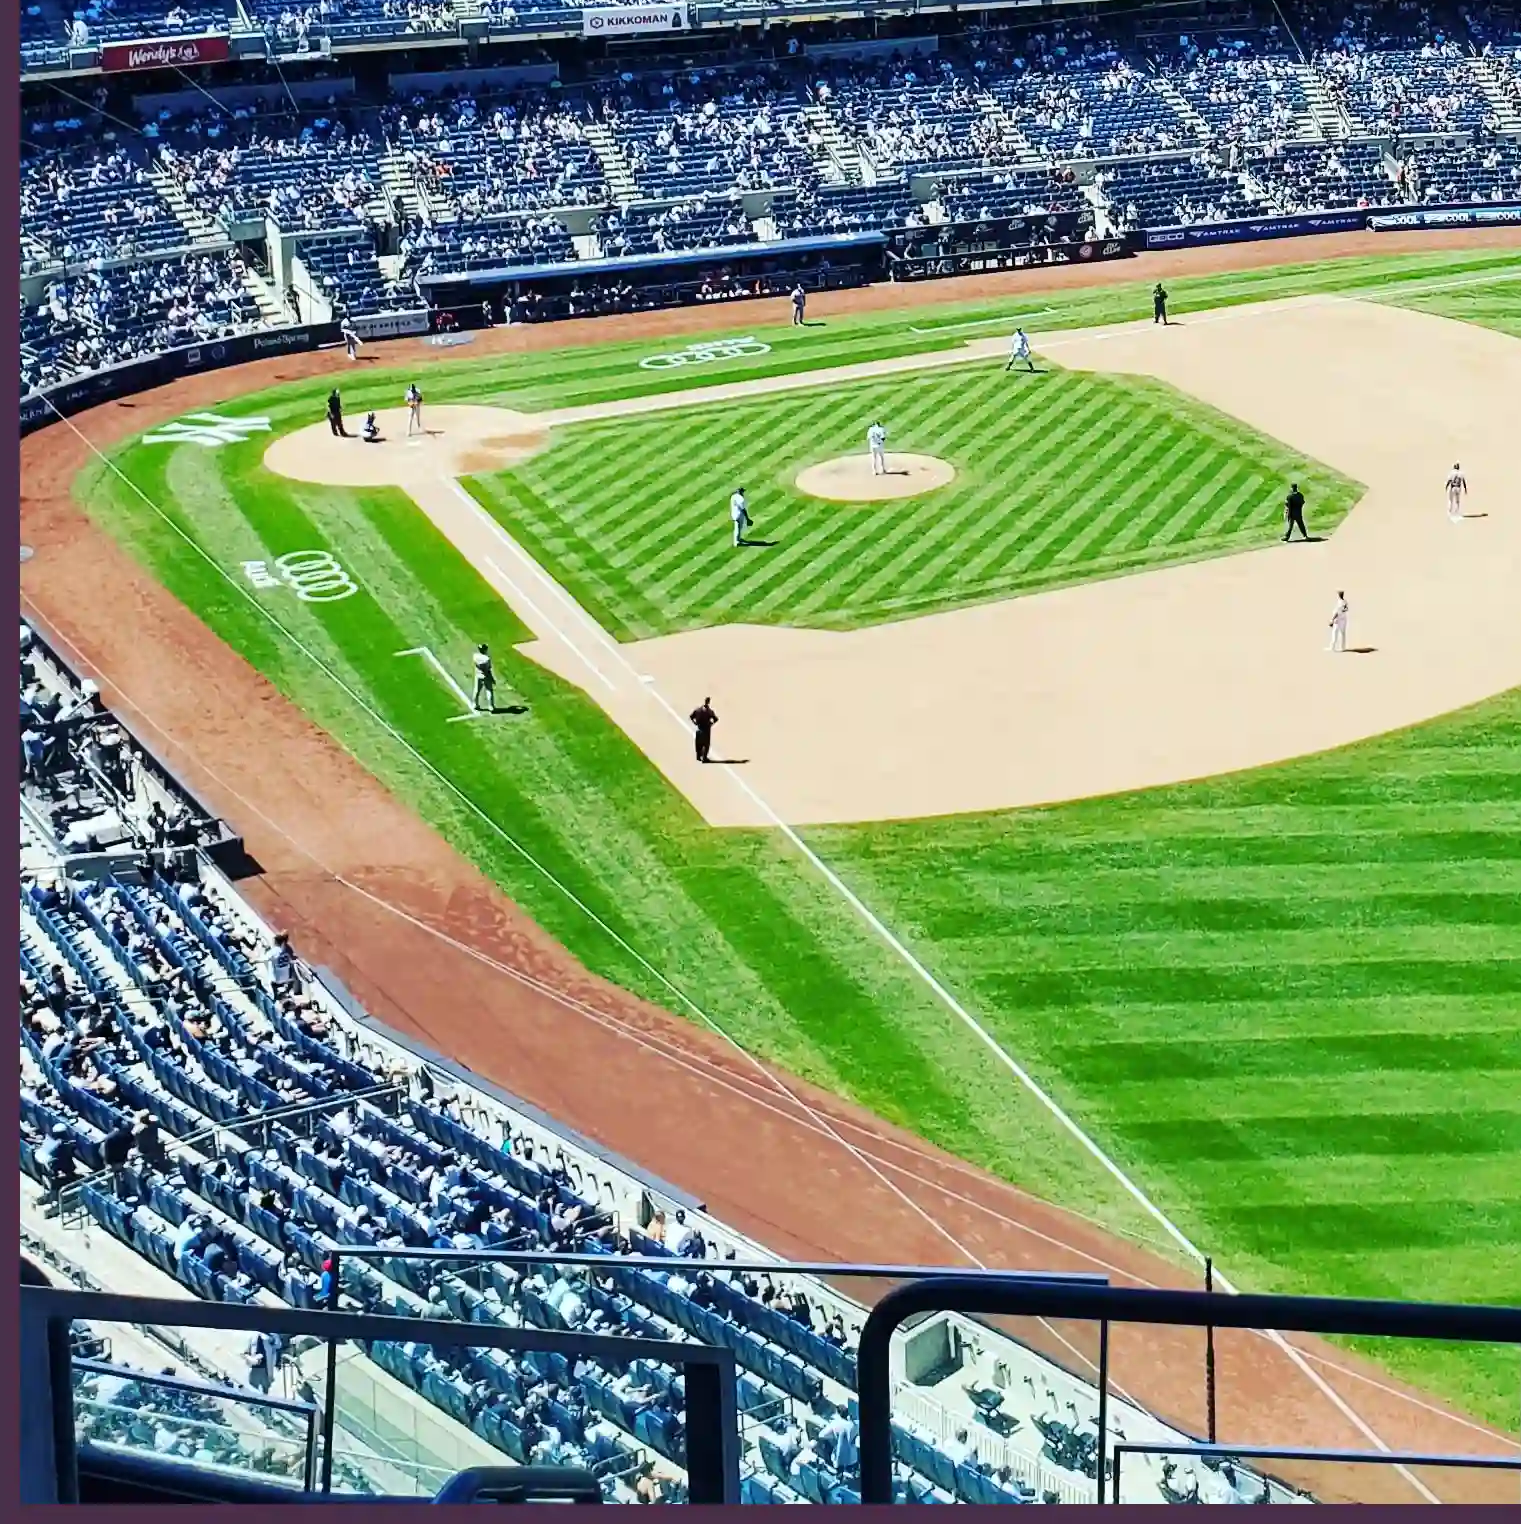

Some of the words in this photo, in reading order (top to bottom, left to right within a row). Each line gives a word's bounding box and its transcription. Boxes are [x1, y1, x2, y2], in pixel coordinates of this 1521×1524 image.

[607, 14, 667, 27] KIKKOMAN
[129, 44, 176, 67] Wendy's
[1149, 232, 1184, 243] GEICO
